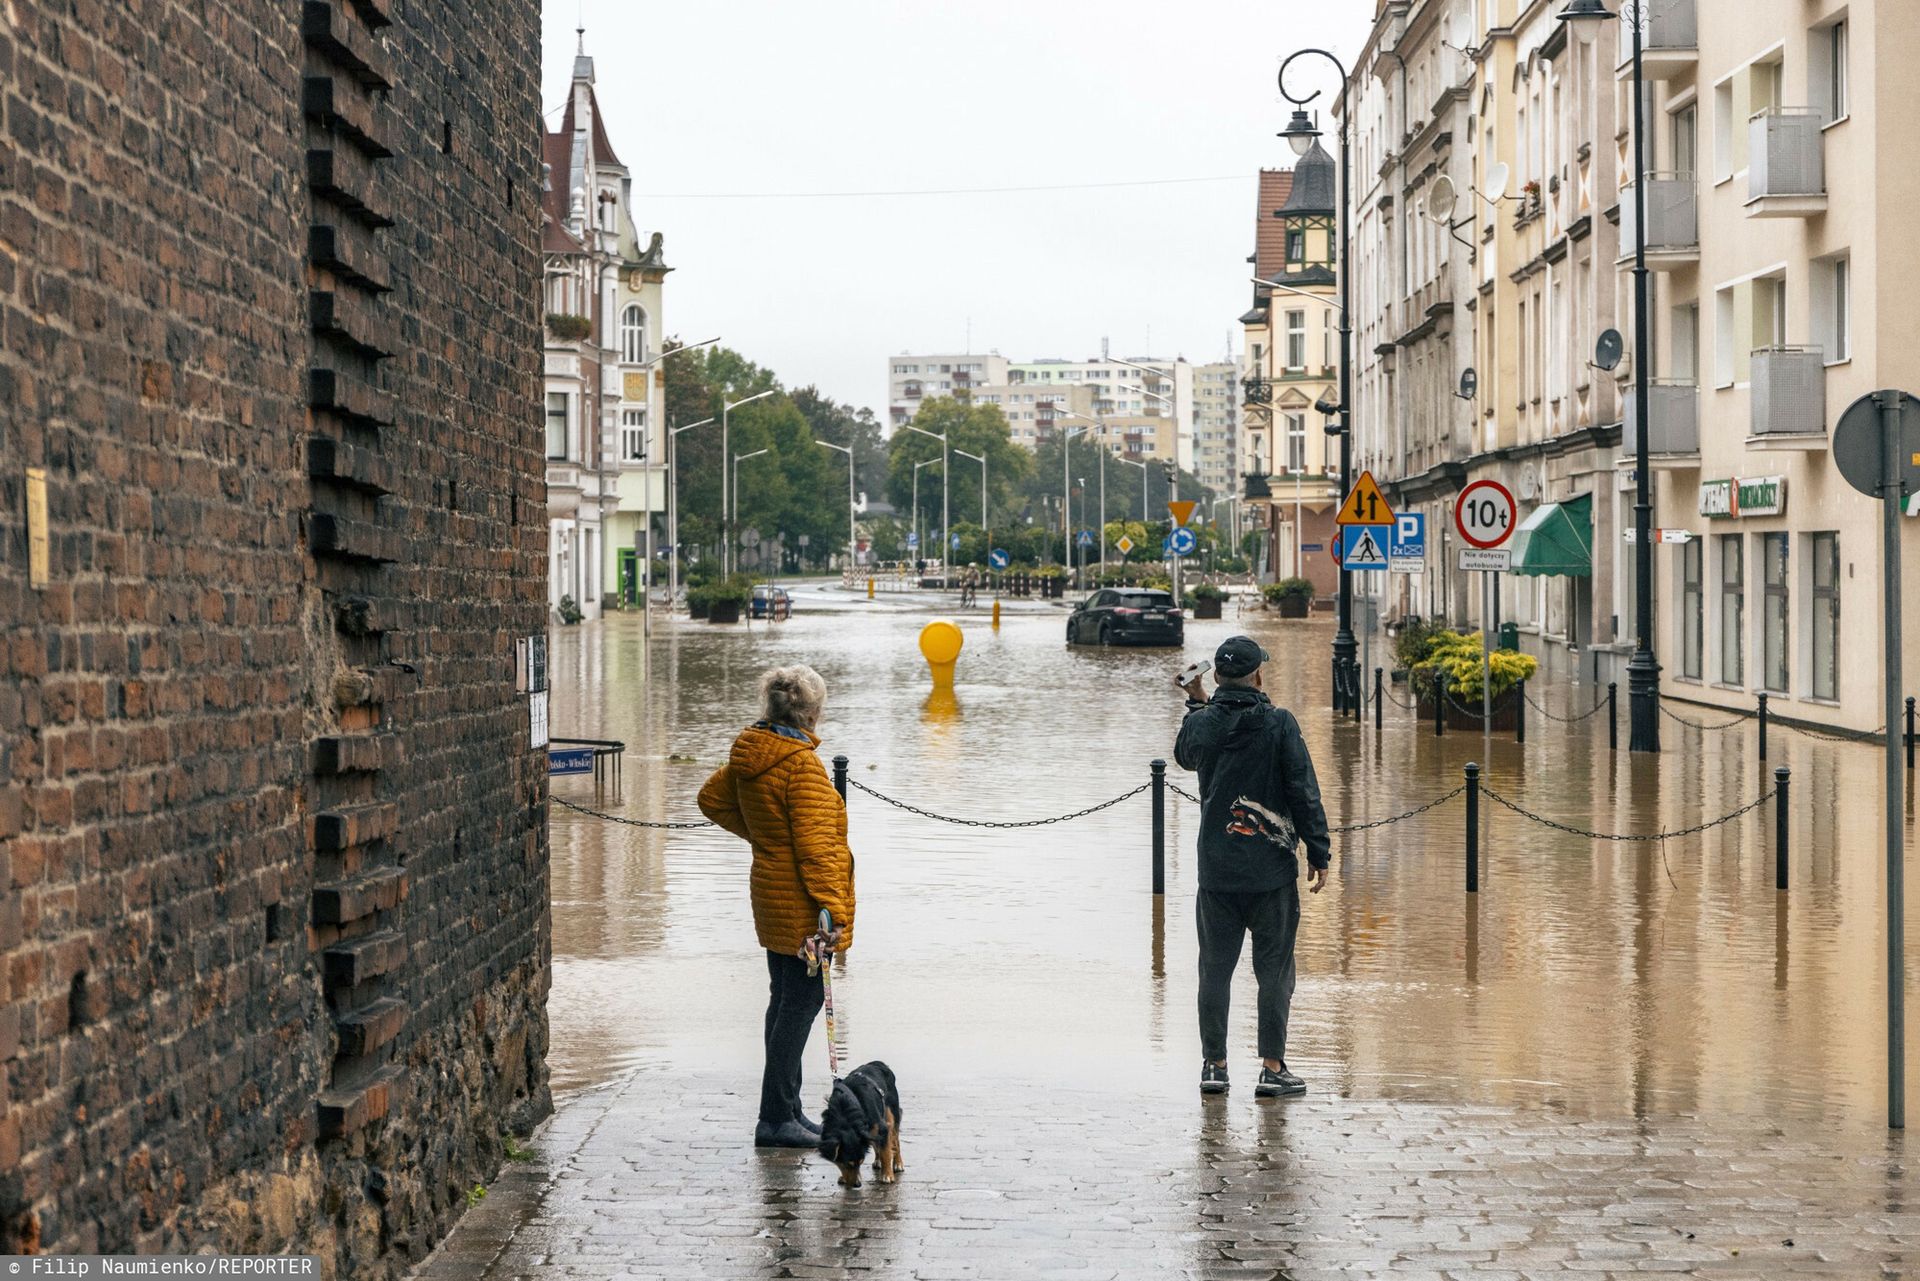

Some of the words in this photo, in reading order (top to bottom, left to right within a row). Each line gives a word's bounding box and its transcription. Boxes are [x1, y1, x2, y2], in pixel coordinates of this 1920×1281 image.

[1398, 516, 1418, 544] P
[1392, 545, 1403, 555] 2x
[1479, 552, 1505, 560] dotyczy
[1465, 561, 1503, 569] autobusów
